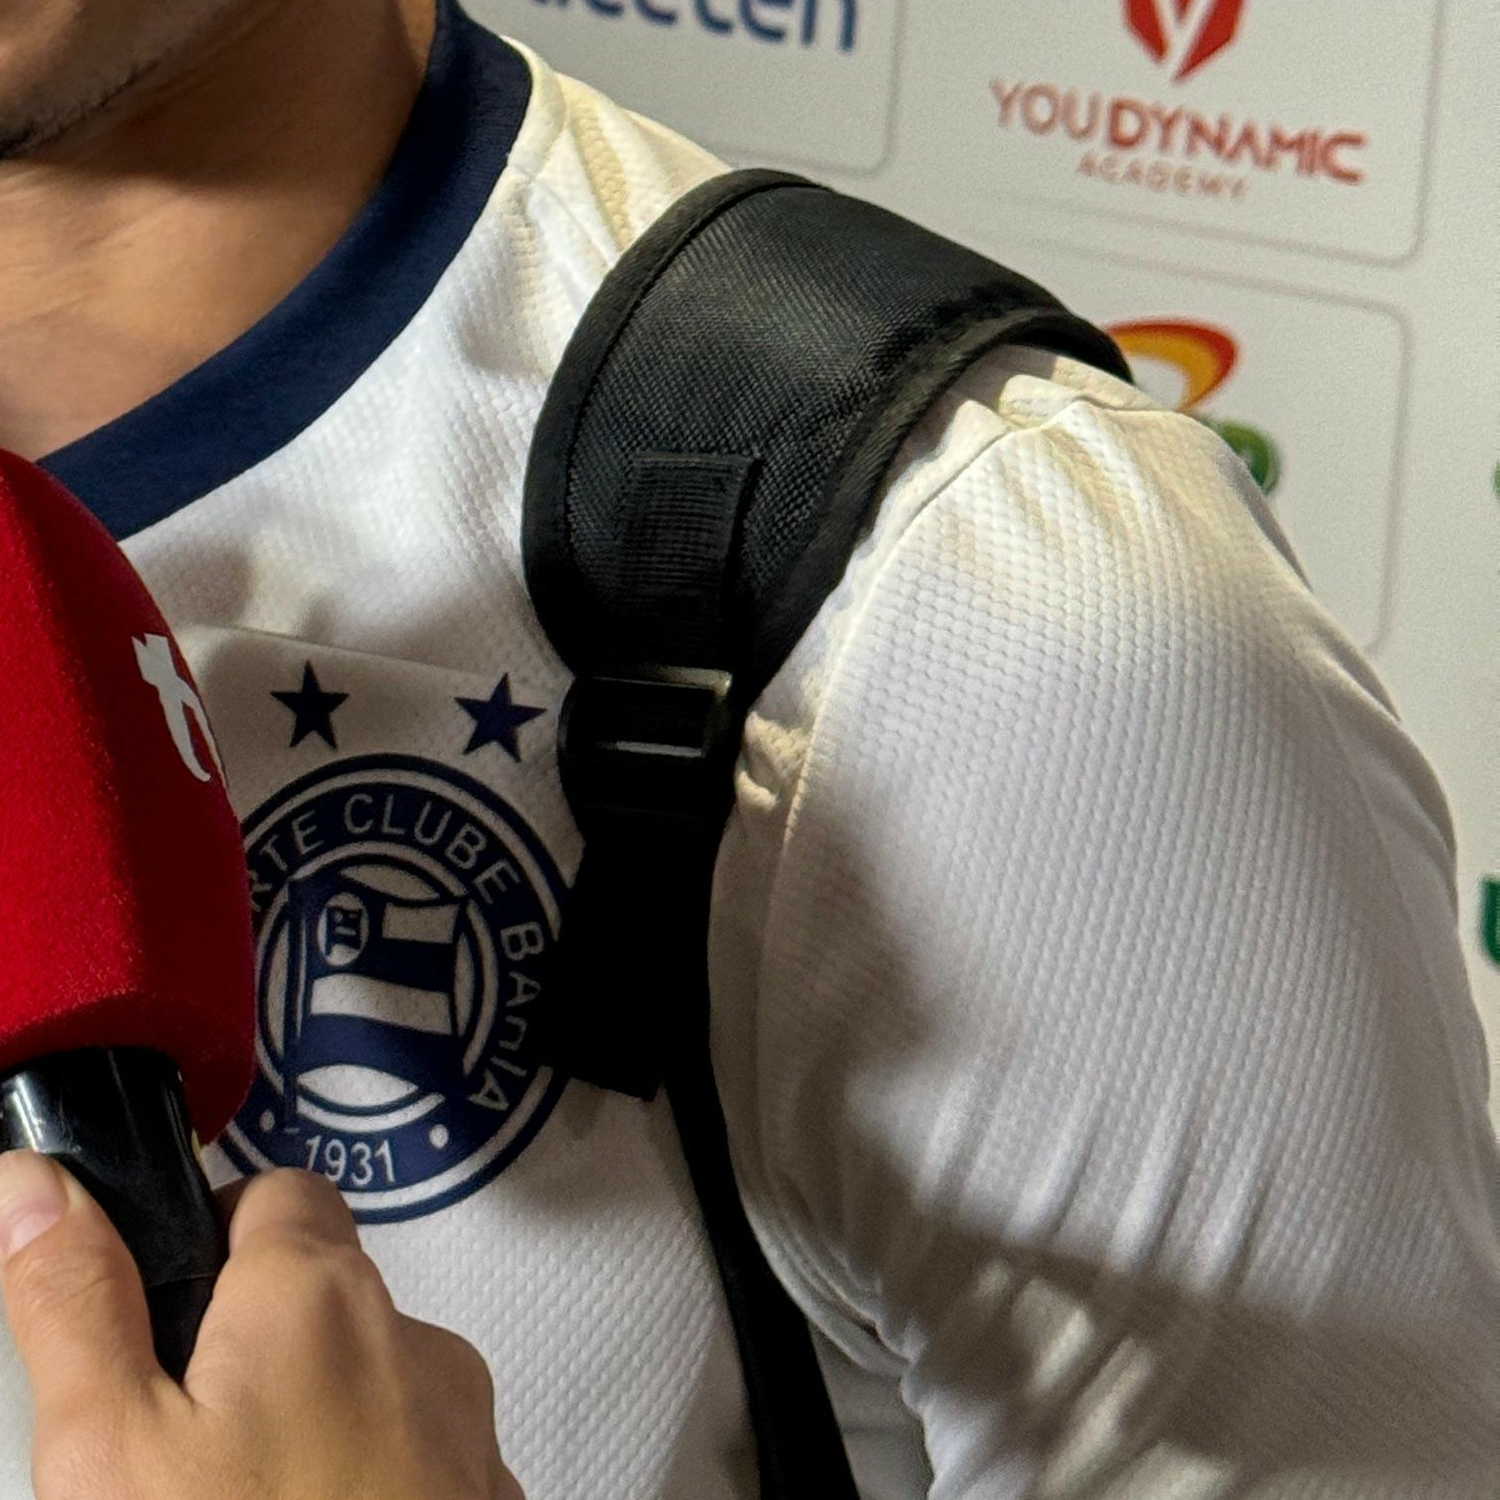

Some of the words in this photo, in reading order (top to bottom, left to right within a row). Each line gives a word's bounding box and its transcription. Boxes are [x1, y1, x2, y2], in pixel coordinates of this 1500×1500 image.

[1076, 154, 1250, 200] ACADEMY
[342, 792, 522, 906] CLUBE
[305, 1134, 397, 1188] 1931
